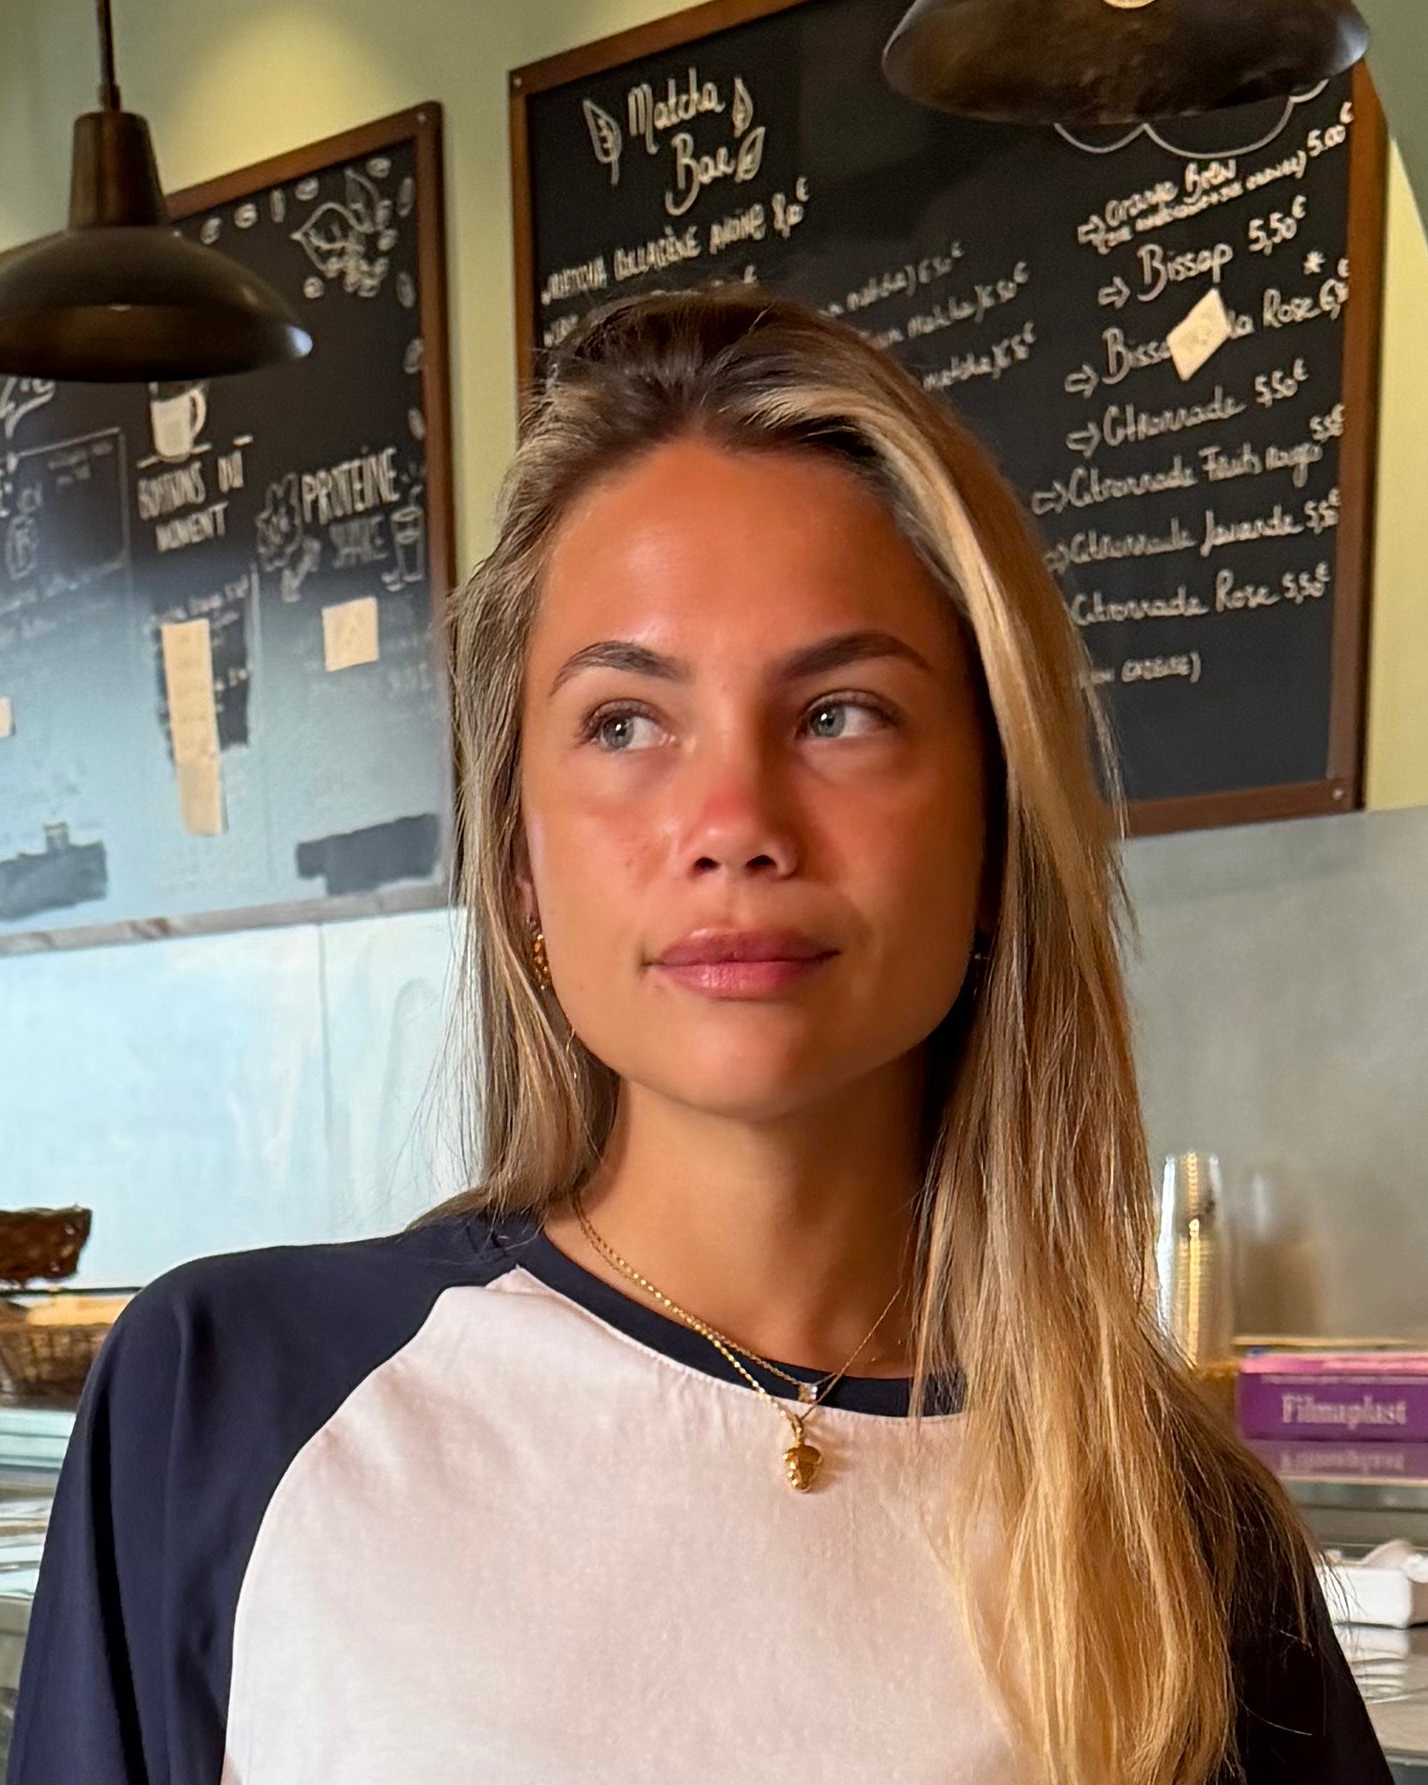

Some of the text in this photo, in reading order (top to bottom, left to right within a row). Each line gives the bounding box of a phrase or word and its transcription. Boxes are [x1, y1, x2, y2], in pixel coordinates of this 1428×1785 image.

[1136, 243, 1234, 301] Bissap
[1215, 567, 1280, 613] Rose
[1282, 1393, 1408, 1431] Filmaplast
